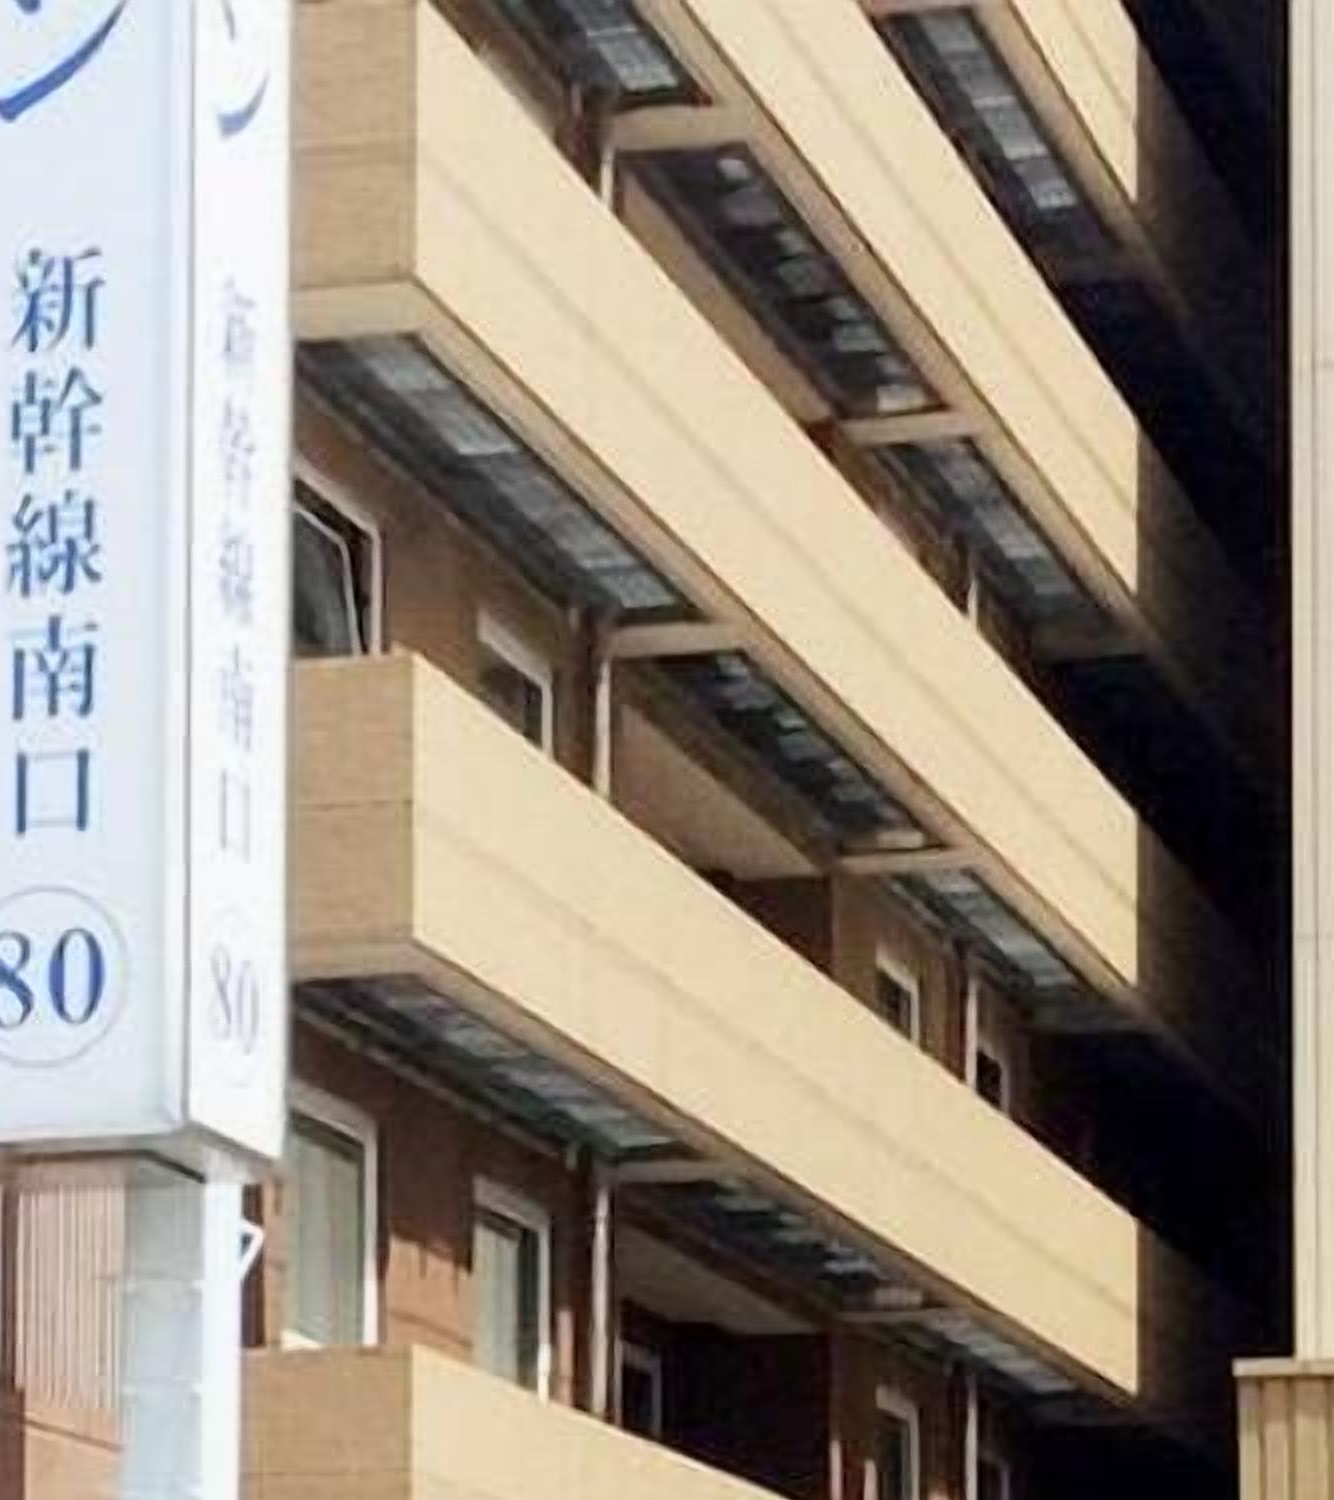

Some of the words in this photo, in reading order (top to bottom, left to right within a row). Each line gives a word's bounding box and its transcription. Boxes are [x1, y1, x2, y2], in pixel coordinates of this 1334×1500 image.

[5, 246, 106, 837] 新幹線南口
[210, 943, 260, 1057] 80
